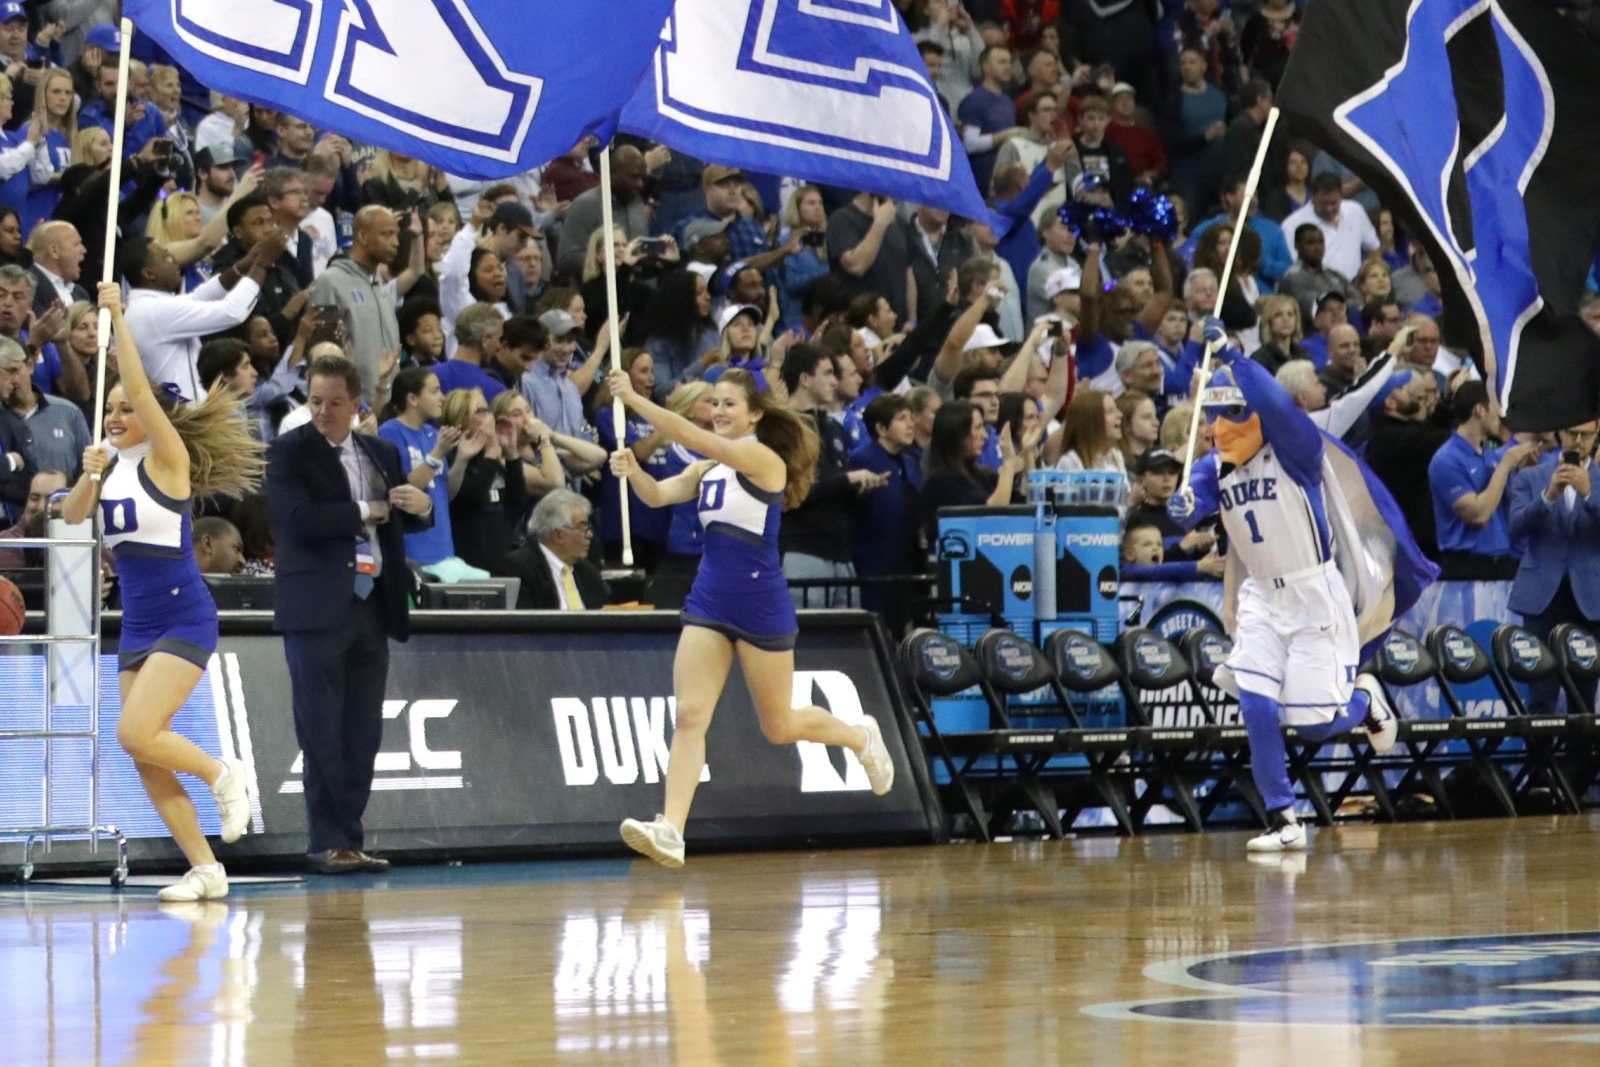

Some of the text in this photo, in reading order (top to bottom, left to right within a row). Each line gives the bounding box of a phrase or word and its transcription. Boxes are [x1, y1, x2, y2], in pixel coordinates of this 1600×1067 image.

[1218, 477, 1278, 512] DUKE
[1244, 509, 1265, 544] 1
[289, 698, 463, 772] CC
[550, 696, 712, 786] DUK
